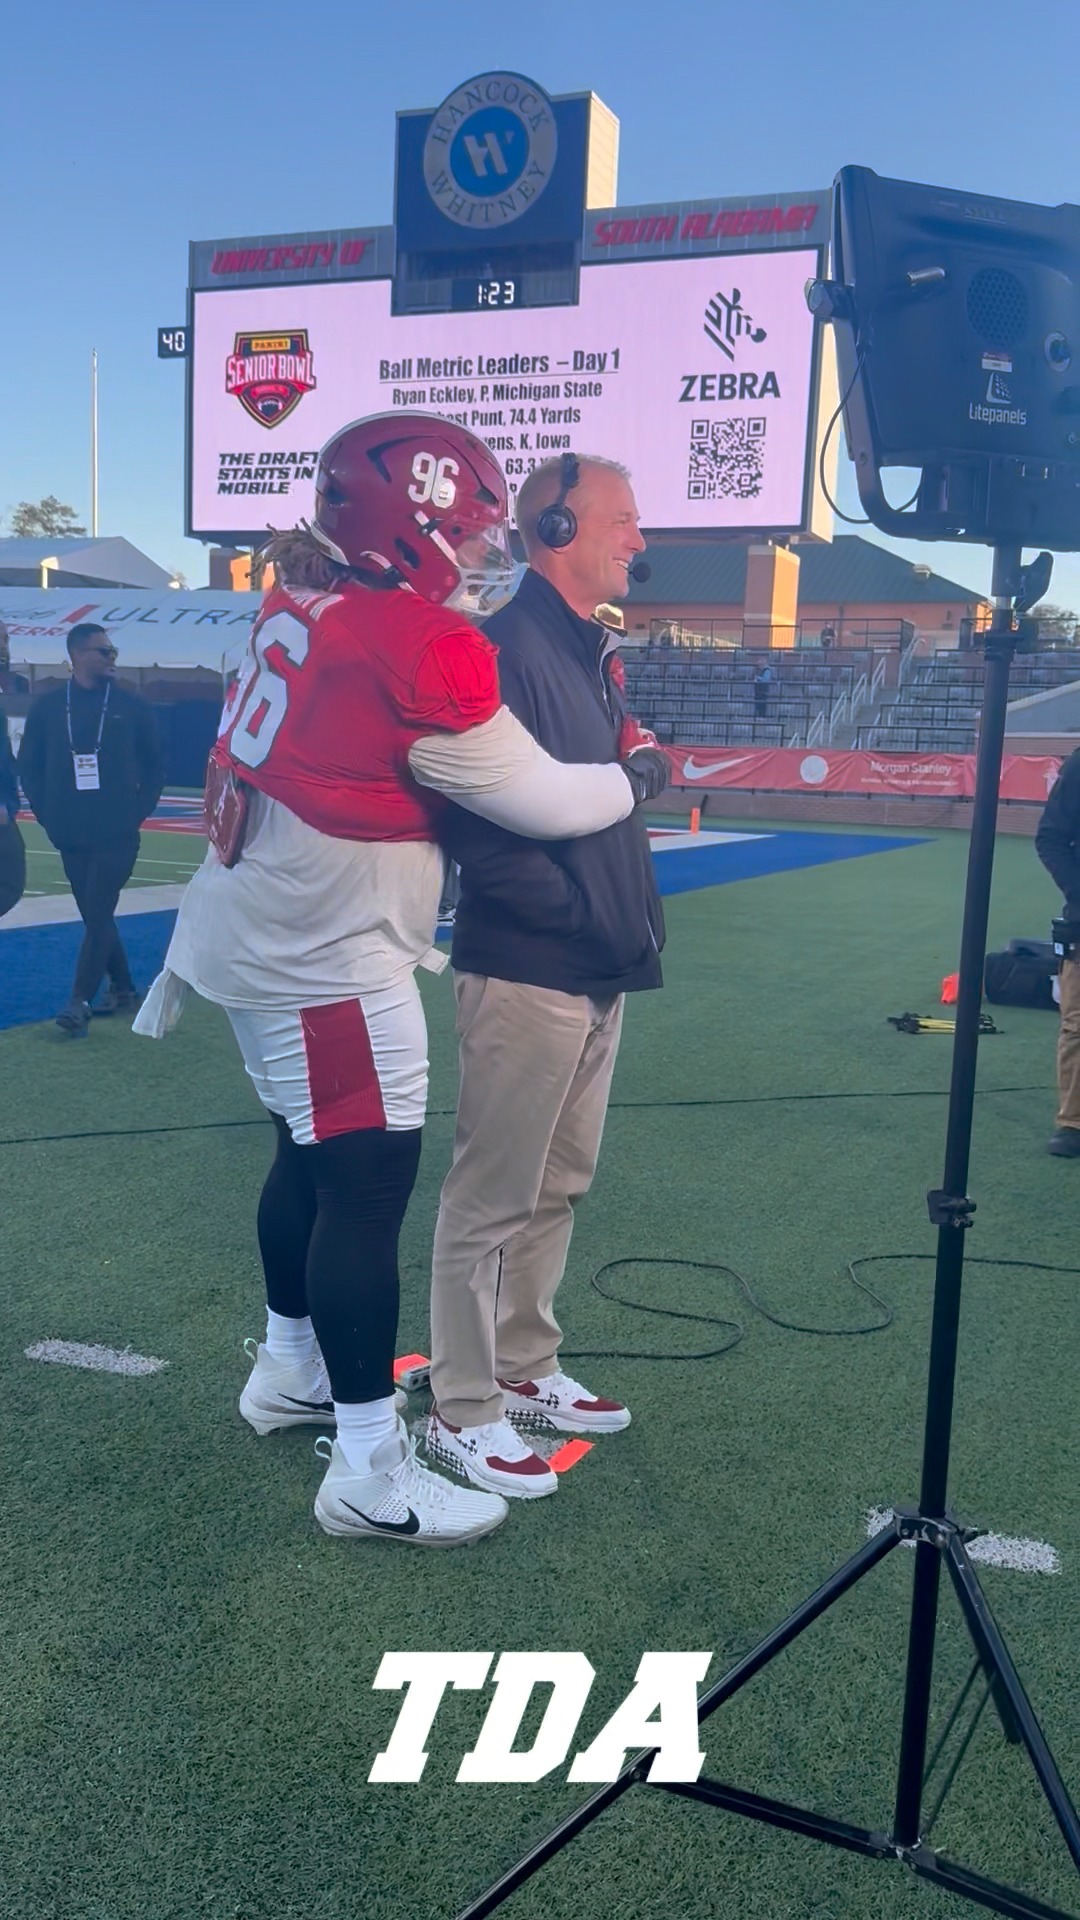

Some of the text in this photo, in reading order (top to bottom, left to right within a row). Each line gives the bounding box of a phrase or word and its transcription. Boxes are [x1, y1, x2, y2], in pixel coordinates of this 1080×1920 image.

[431, 80, 550, 144] HANCOCK
[431, 161, 546, 223] WHITNEY
[592, 204, 820, 247] SOUTH ALABAMA
[211, 239, 375, 275] UNIVERSITY OF
[477, 281, 515, 305] 1:23
[162, 330, 185, 351] 40
[228, 353, 315, 388] SENIOR BOWL
[379, 358, 412, 380] Ball
[417, 355, 473, 378] Metric
[477, 353, 550, 375] Leaders
[572, 350, 608, 373] Day
[611, 348, 620, 369] 1
[393, 388, 426, 406] Ryan
[429, 386, 477, 405] Eckley,
[493, 382, 560, 402] Michigan
[564, 381, 602, 398] State
[678, 371, 781, 402] ZEBRA
[471, 409, 507, 426] Punt,
[509, 408, 537, 425] 74.4
[540, 406, 581, 424] Yards
[969, 401, 1027, 425] Litepanels
[520, 433, 533, 450] K,
[536, 433, 571, 449] Iowa
[218, 451, 319, 466] THE DRAFT
[505, 457, 536, 475] 63.3
[217, 466, 315, 480] STARTS IN
[408, 452, 460, 508] 96
[217, 482, 291, 495] MOBILE
[102, 607, 258, 625] ULTRA
[871, 761, 952, 777] Morgan Stanley
